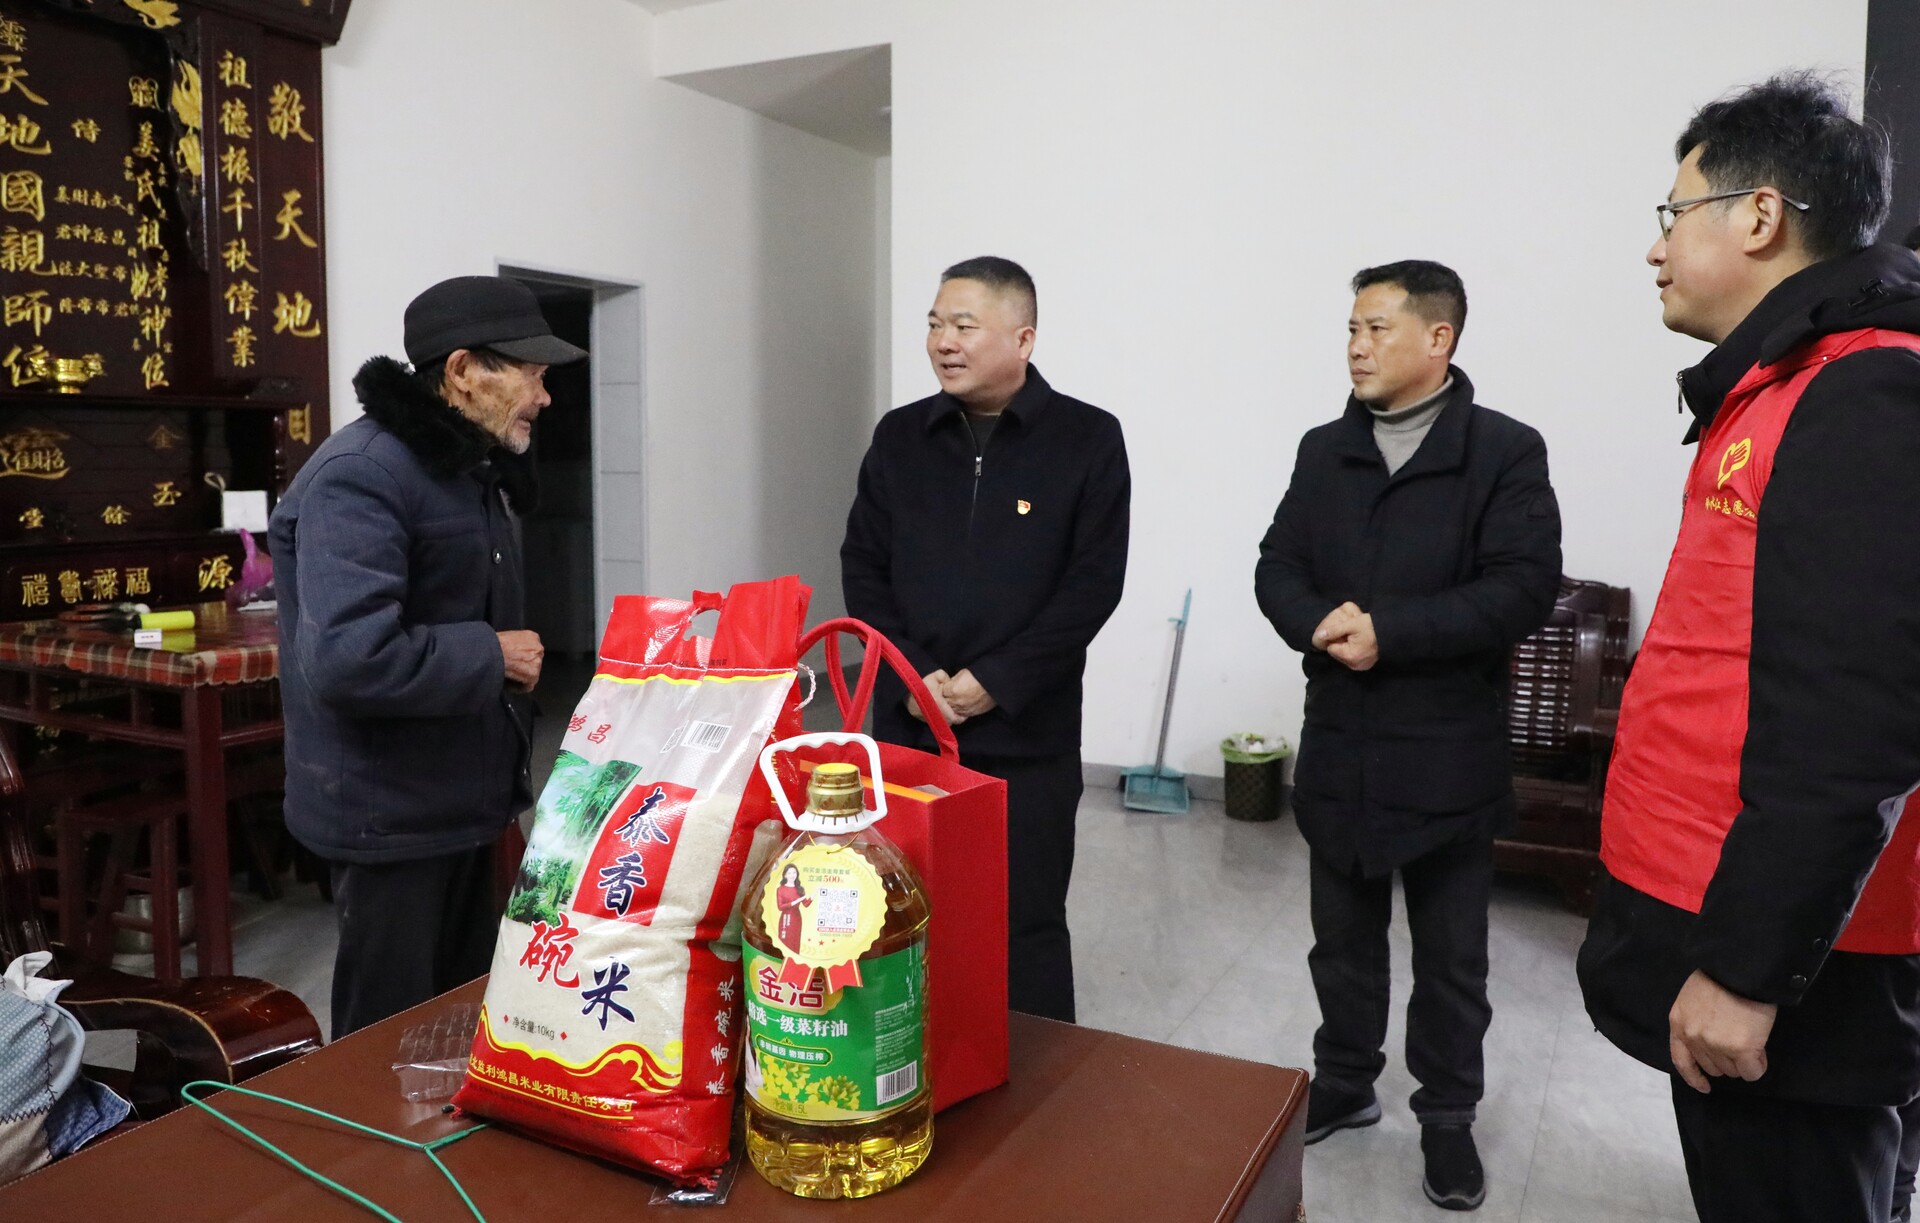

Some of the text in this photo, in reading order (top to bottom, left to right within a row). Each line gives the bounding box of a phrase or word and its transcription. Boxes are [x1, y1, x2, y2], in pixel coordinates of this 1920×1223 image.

[217, 49, 260, 368] 祖德振千秋偉業
